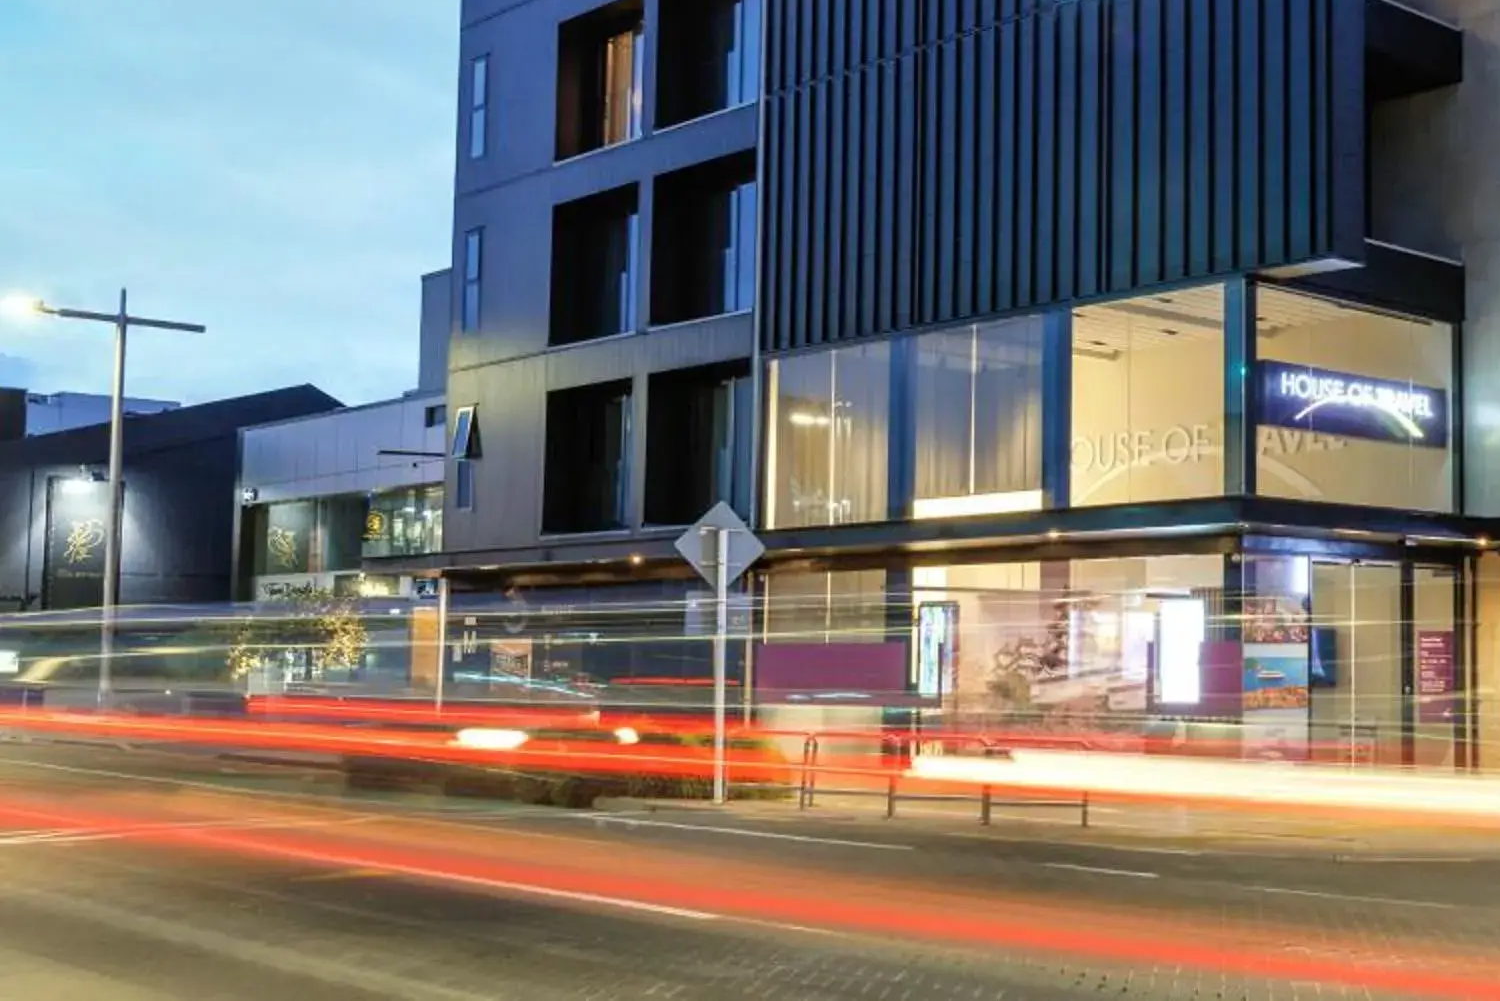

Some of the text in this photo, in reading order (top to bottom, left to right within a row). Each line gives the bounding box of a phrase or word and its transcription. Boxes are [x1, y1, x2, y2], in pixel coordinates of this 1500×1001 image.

[1281, 371, 1434, 418] HOUSE OF TRAVEL
[1071, 431, 1152, 472] OUSE
[1162, 424, 1210, 467] OF
